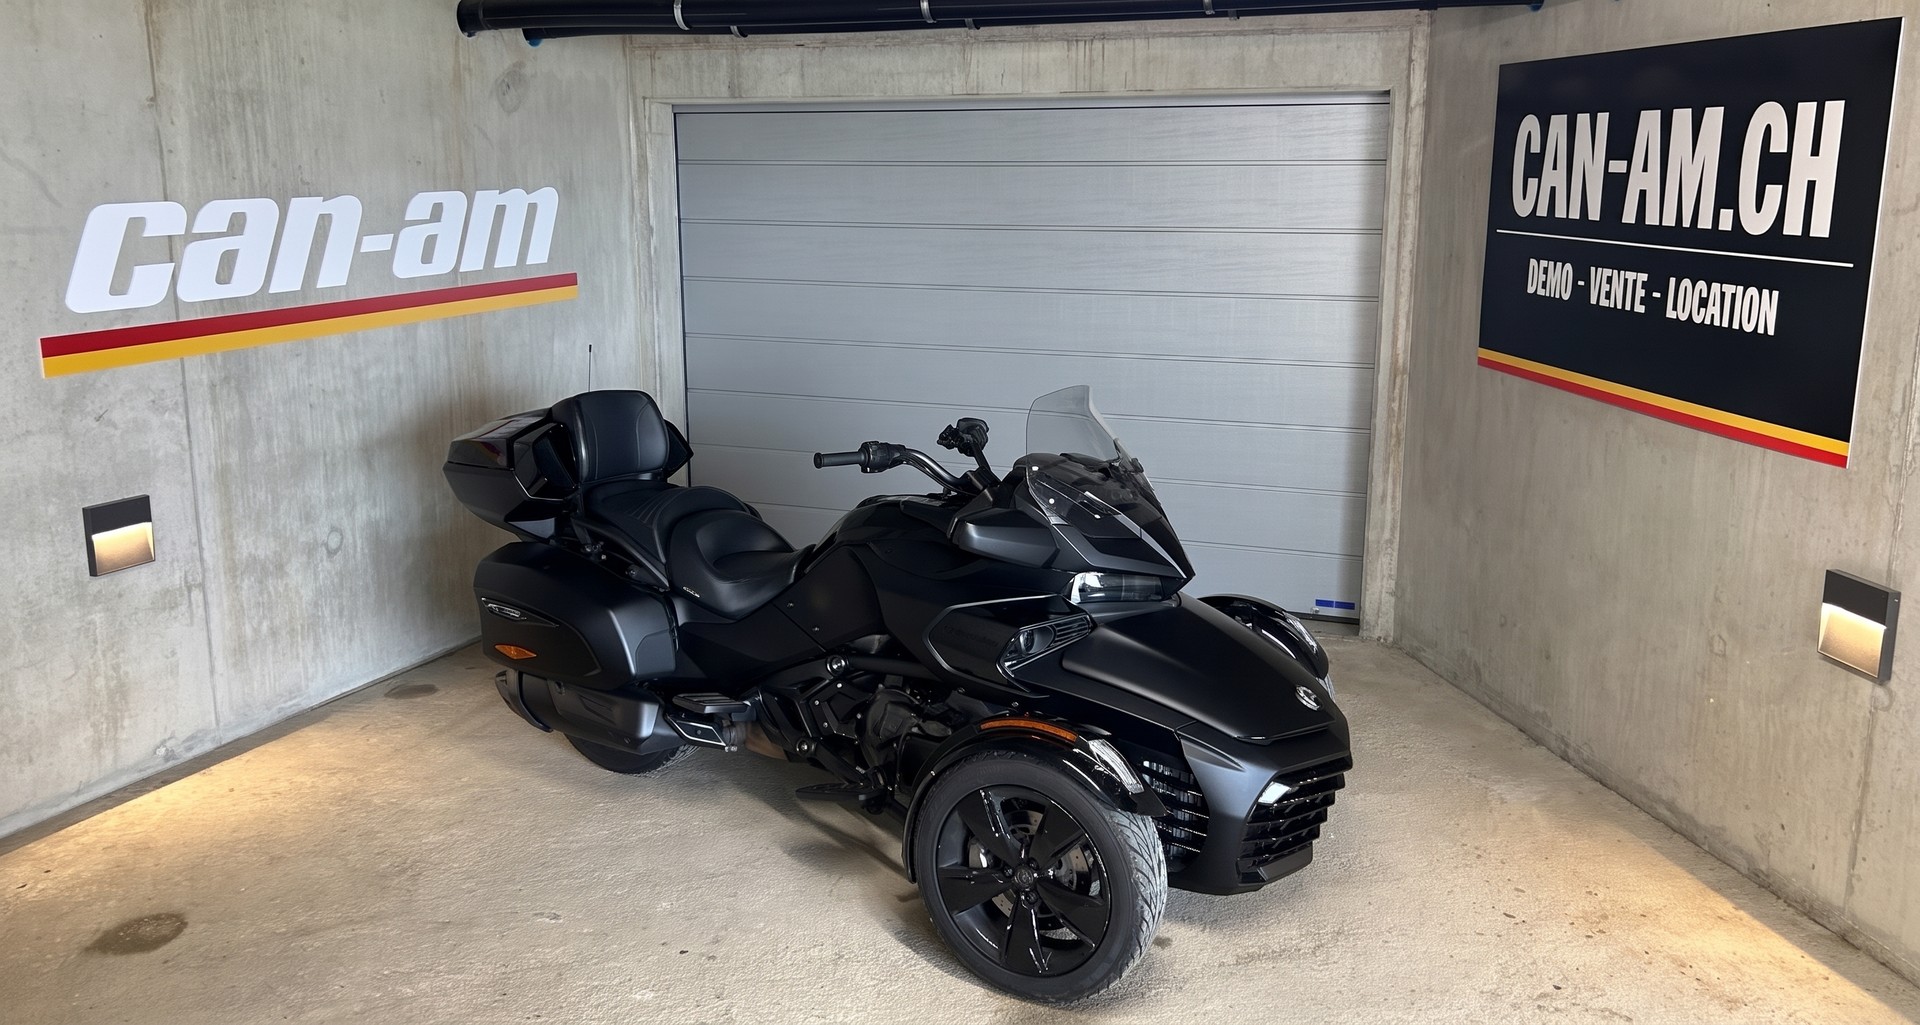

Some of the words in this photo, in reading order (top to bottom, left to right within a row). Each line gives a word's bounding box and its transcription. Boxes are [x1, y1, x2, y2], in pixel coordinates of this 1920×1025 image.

[1512, 99, 1846, 238] CAN-AM.CH
[64, 186, 560, 314] can-am
[1526, 258, 1574, 301] DEMO
[1589, 266, 1649, 314] VENTE
[1665, 276, 1780, 336] LOCATION
